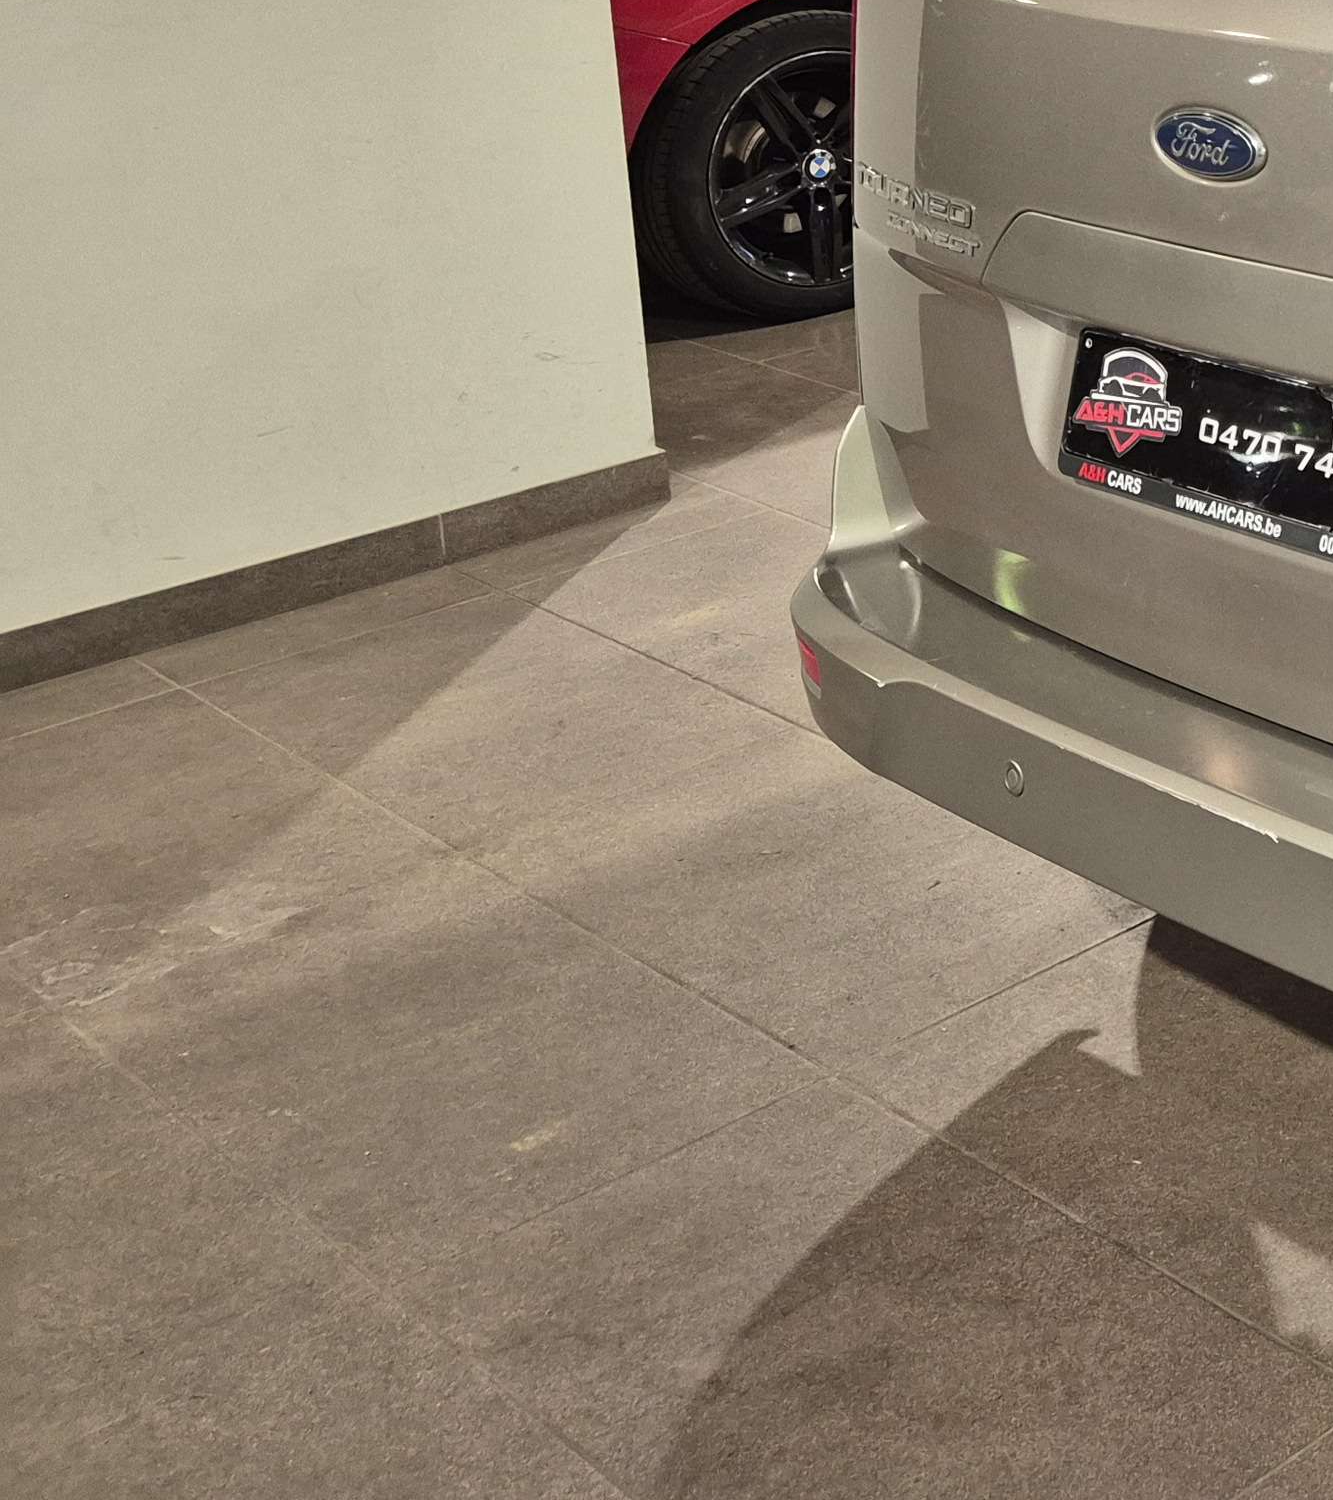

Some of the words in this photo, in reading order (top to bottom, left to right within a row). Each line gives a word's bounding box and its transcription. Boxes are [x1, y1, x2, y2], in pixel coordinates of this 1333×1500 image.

[1171, 121, 1230, 165] Ford
[857, 161, 976, 229] TOURNEO
[1126, 404, 1181, 433] CARS
[1199, 416, 1281, 460] 0470
[1078, 462, 1108, 483] A&H
[1107, 470, 1142, 495] CARS
[1175, 493, 1282, 538] www.AHCARS.be
